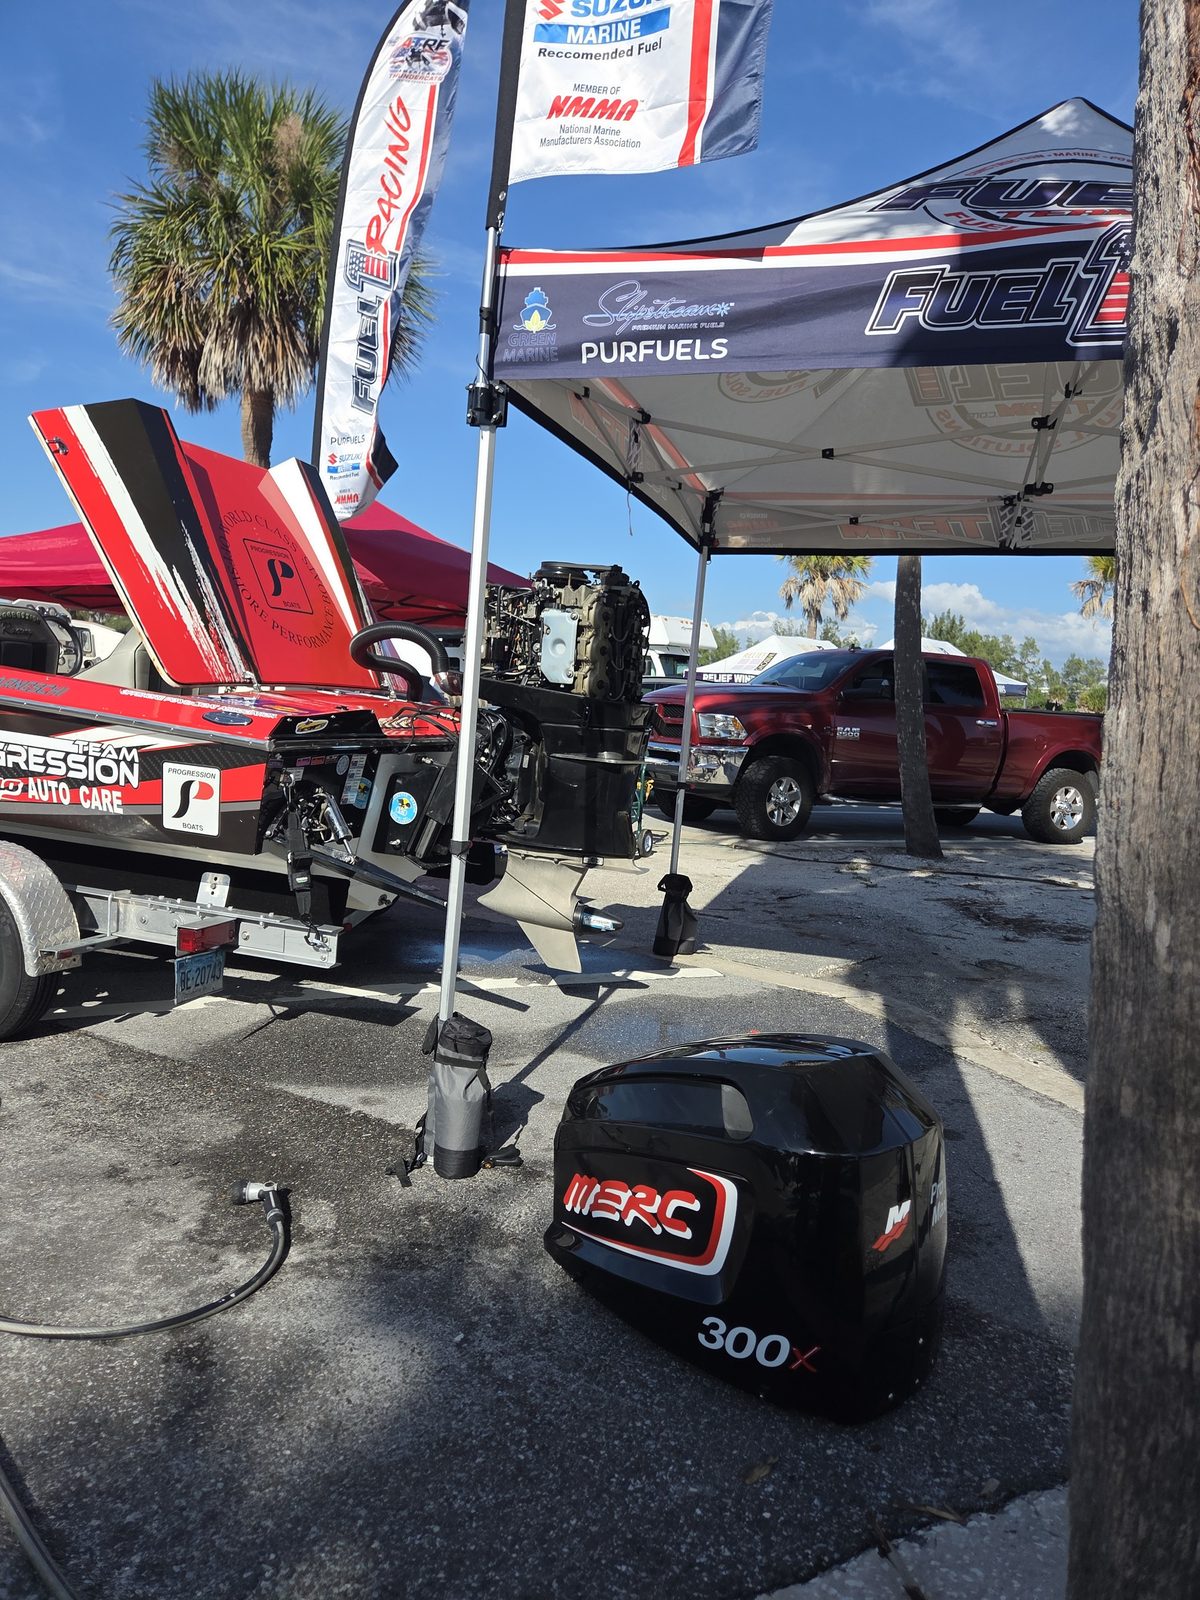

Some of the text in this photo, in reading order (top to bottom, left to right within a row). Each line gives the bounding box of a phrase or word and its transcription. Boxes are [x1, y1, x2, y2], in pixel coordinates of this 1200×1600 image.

[566, 19, 641, 44] MARINE
[538, 37, 662, 60] Reccomended Fuel
[573, 83, 621, 95] MEMBER OF
[546, 95, 639, 121] NMMA
[540, 135, 641, 148] Manufacturers Association
[559, 124, 621, 136] National Marine
[366, 96, 411, 256] RACING
[583, 280, 718, 336] Slipstream
[632, 322, 725, 332] PREMIUM MARINE FUELS
[508, 332, 557, 347] GREEN
[581, 338, 729, 364] PURFUELS
[502, 347, 559, 362] MARINE
[254, 514, 297, 553] CLASS
[702, 673, 733, 682] RELIEF
[73, 740, 139, 763] TEAM
[168, 767, 216, 779] PROGRESSION
[28, 777, 70, 805] AUTO
[80, 785, 124, 814] CARE
[182, 822, 204, 832] BOATS
[563, 1173, 700, 1240] MERC
